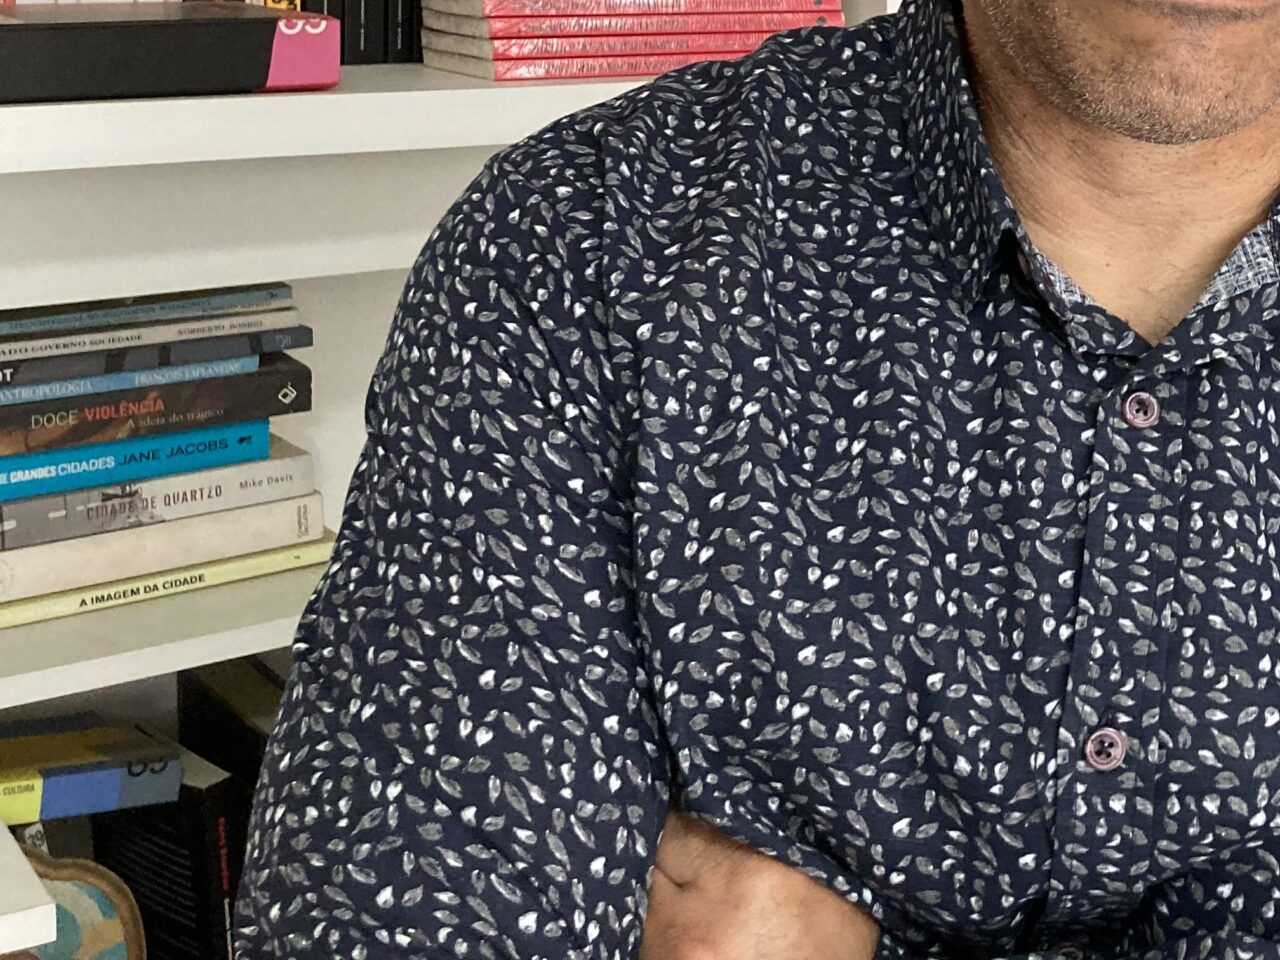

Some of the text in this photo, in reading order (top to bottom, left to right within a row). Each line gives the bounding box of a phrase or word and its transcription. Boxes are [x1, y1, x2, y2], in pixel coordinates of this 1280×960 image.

[31, 398, 165, 429] DOCE VIOLÊNCIA
[10, 438, 230, 483] GRANDES CIDADES JANE JACOBS
[86, 473, 294, 520] CIDADE DE QUARTZO Mike Davis
[79, 573, 206, 608] A IMAGEM DA CIDADE
